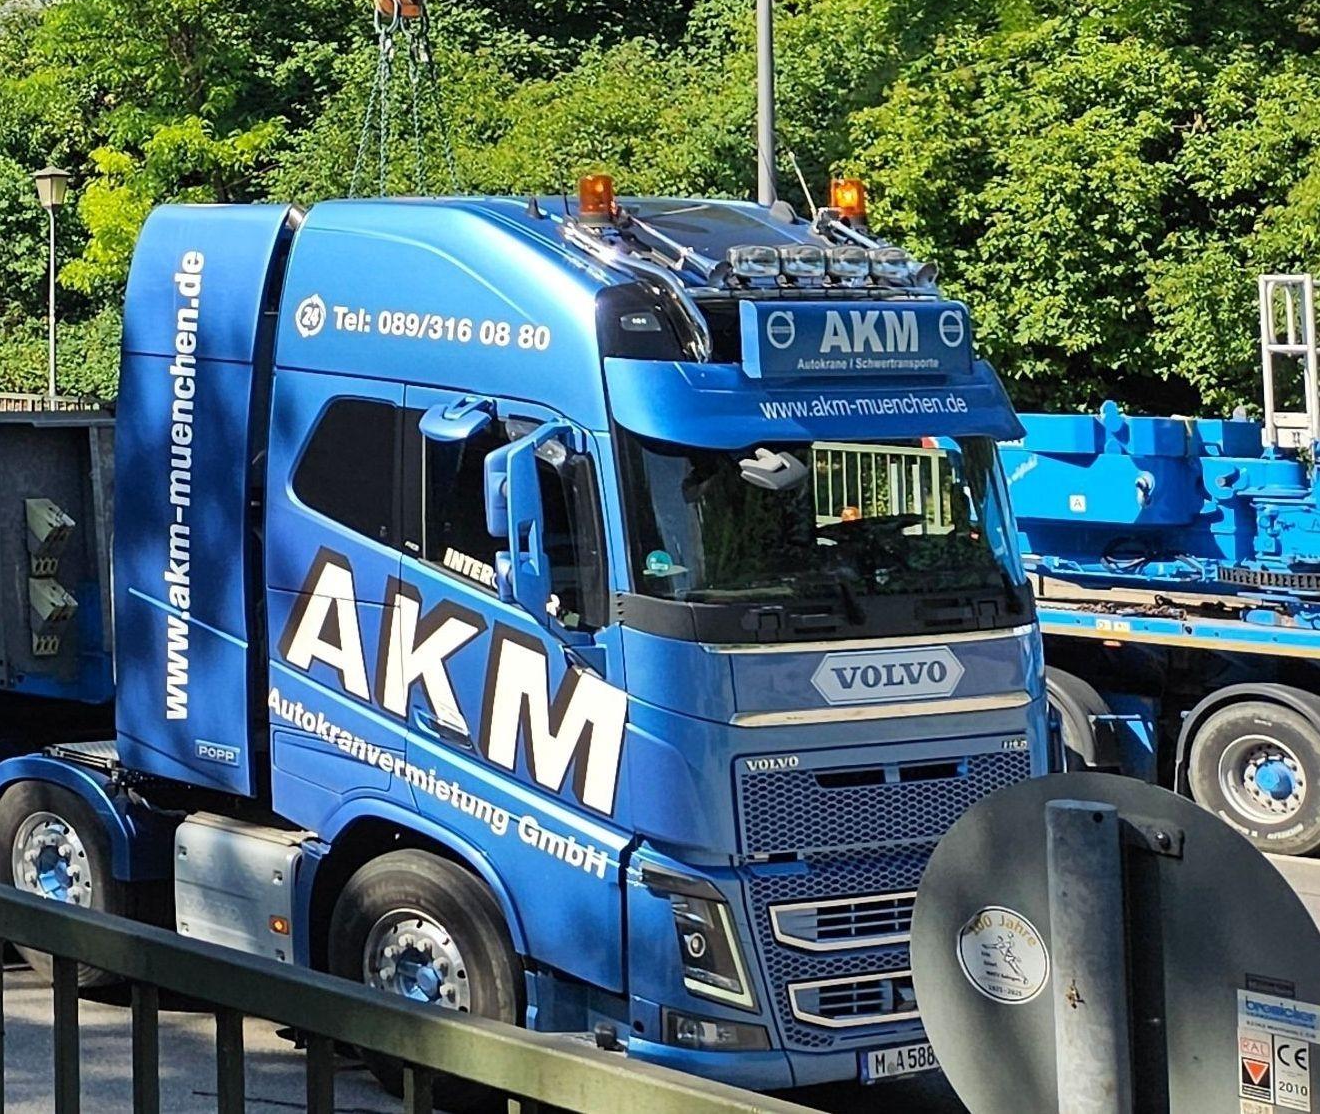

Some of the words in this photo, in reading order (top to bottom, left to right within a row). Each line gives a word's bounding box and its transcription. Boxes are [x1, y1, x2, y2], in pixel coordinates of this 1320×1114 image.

[302, 306, 319, 326] 24
[333, 306, 371, 333] Tel:
[377, 310, 473, 342] 089/316
[479, 320, 511, 346] 08
[517, 324, 551, 351] 80
[819, 310, 919, 353] AKM
[797, 358, 847, 370] Autokrane
[855, 358, 939, 371] Schwertransporte
[759, 393, 968, 420] www.akm-muenchen.de
[165, 249, 205, 721] www.akm-muenchen.de
[280, 547, 628, 817] AKM
[830, 660, 947, 689] VOLVO
[198, 745, 236, 762] POPP
[744, 755, 799, 771] VOLVO
[267, 686, 511, 836] Autokranvermietung
[517, 814, 609, 880] GmbH
[1000, 914, 1037, 947] Jahre
[875, 1053, 886, 1074] M
[1278, 1080, 1308, 1097] 2010
